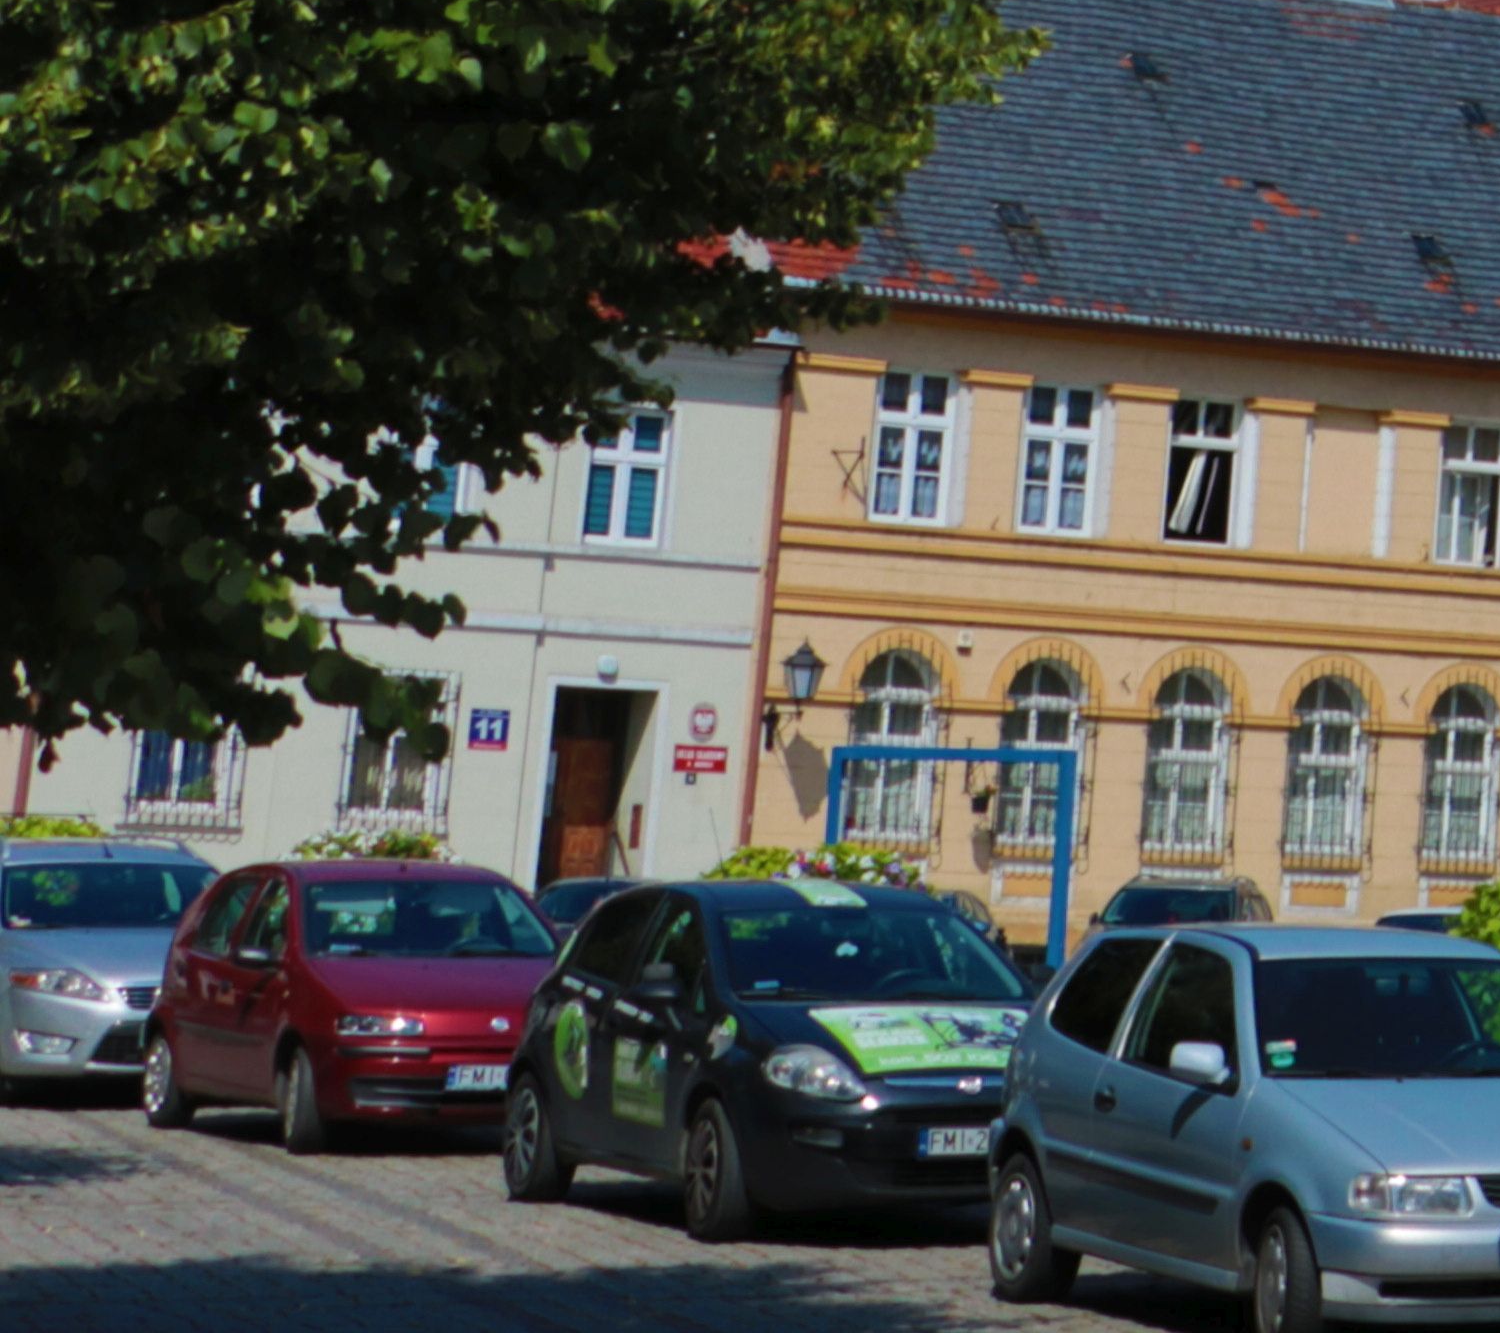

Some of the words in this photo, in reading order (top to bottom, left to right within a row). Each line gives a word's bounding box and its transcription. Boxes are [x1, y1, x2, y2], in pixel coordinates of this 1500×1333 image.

[475, 718, 503, 740] 11
[459, 1066, 495, 1084] FMI
[930, 1130, 965, 1152] FMI
